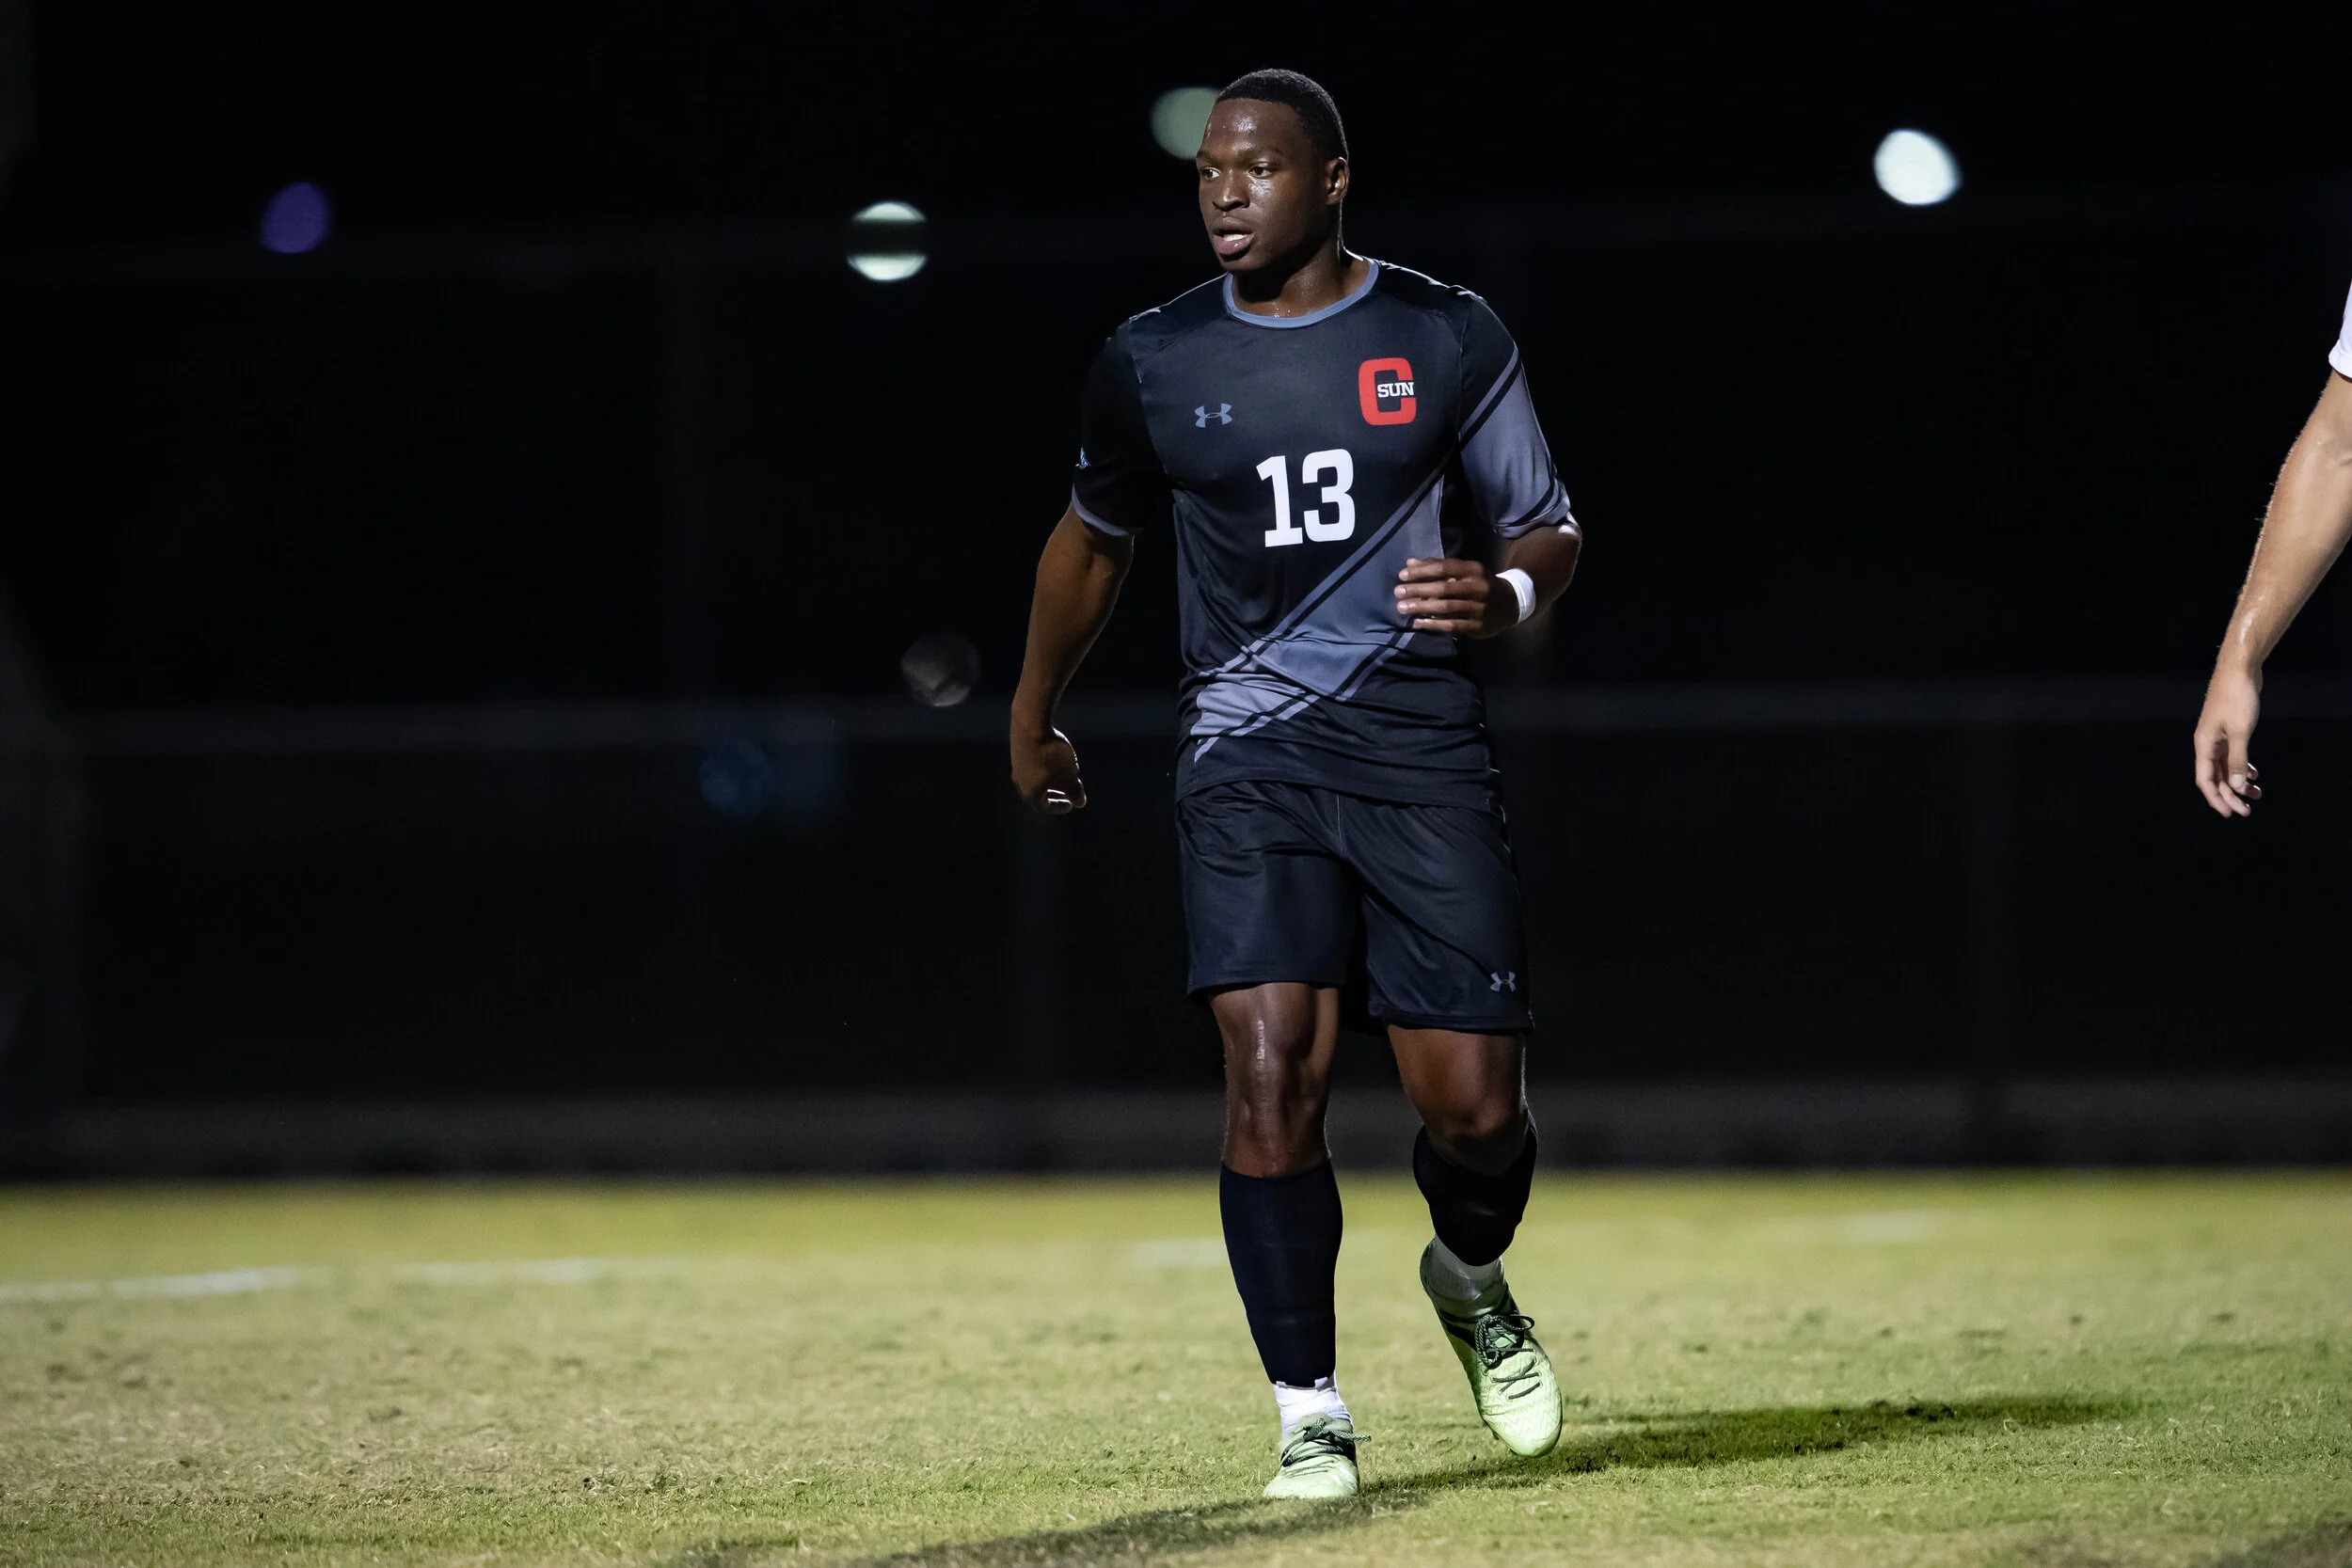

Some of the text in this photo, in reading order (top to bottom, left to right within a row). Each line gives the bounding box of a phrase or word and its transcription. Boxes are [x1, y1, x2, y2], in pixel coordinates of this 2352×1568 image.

[1359, 357, 1417, 426] C SUN
[1256, 449, 1356, 547] 13
